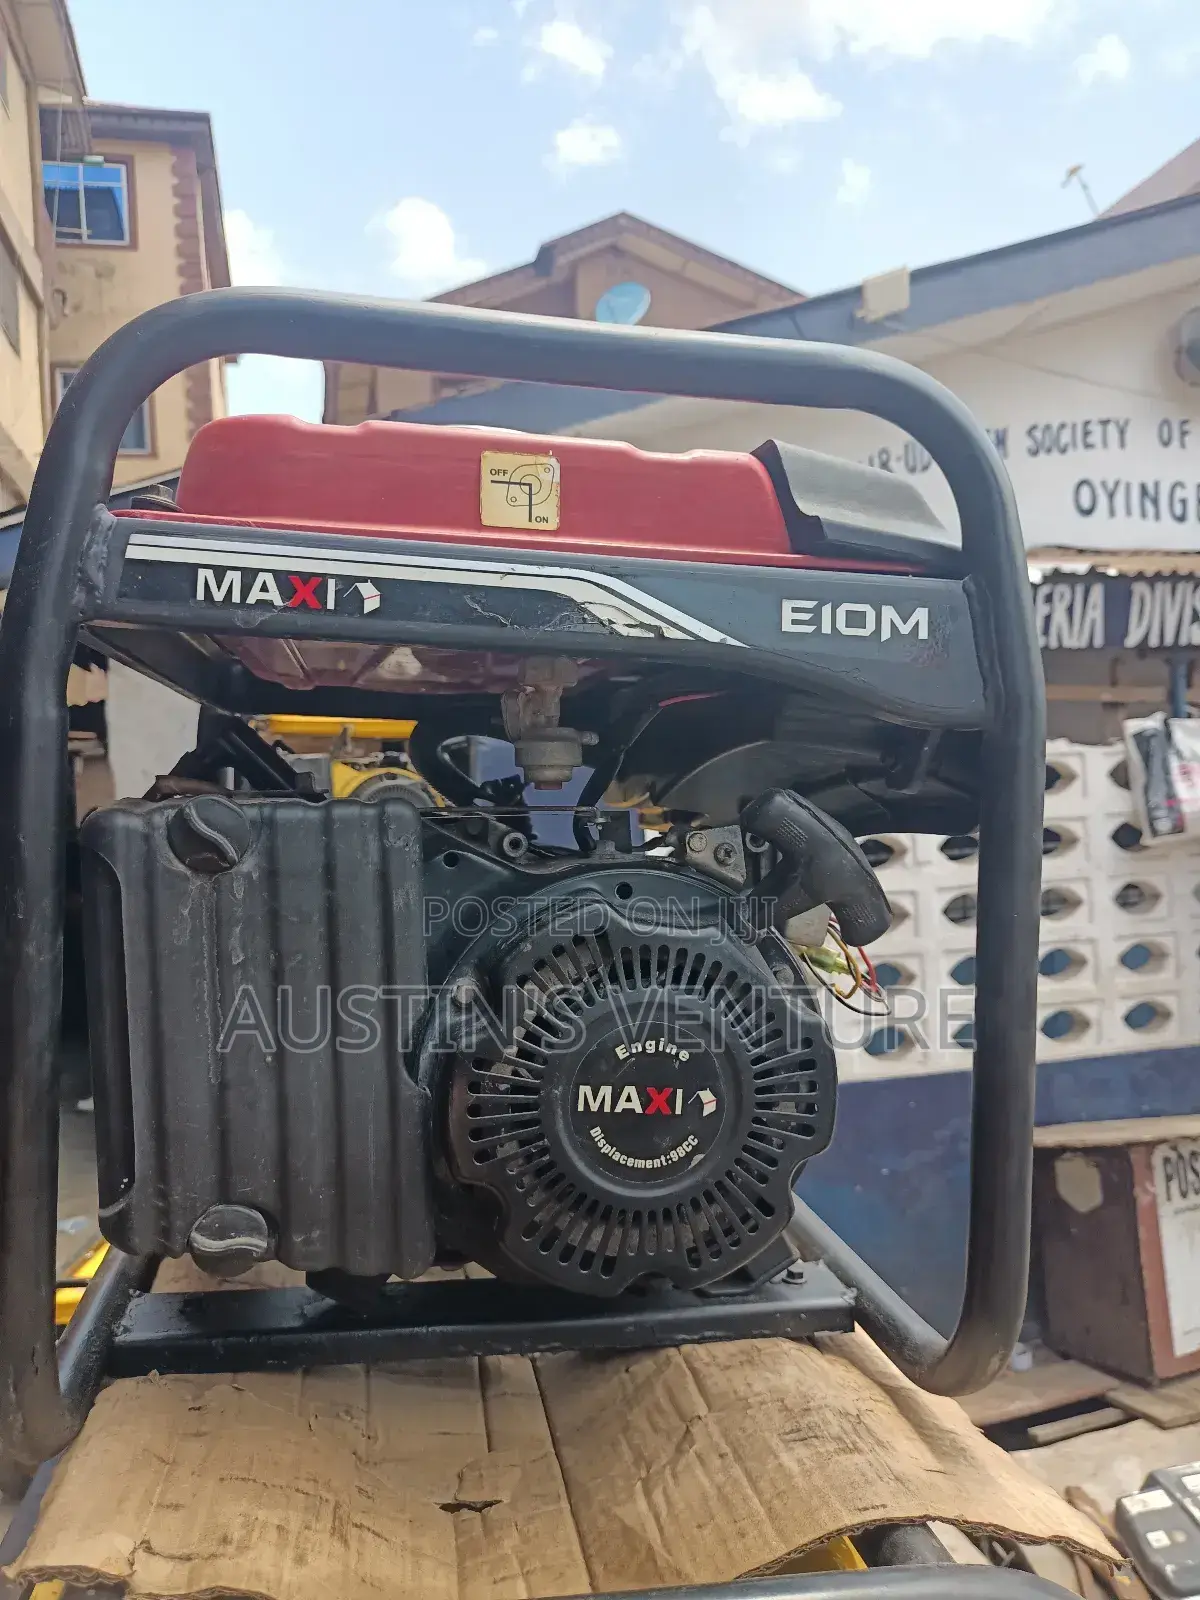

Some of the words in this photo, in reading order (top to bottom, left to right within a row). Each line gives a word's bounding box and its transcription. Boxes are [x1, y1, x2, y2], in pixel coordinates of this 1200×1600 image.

[1026, 418, 1130, 457] SOCIETY
[1157, 418, 1191, 449] OF
[489, 468, 508, 477] OFF
[534, 515, 549, 524] ON
[196, 568, 335, 610] MAXI
[1034, 582, 1105, 650] ERIA
[614, 1037, 690, 1062] Engine
[577, 1085, 684, 1115] MAXI
